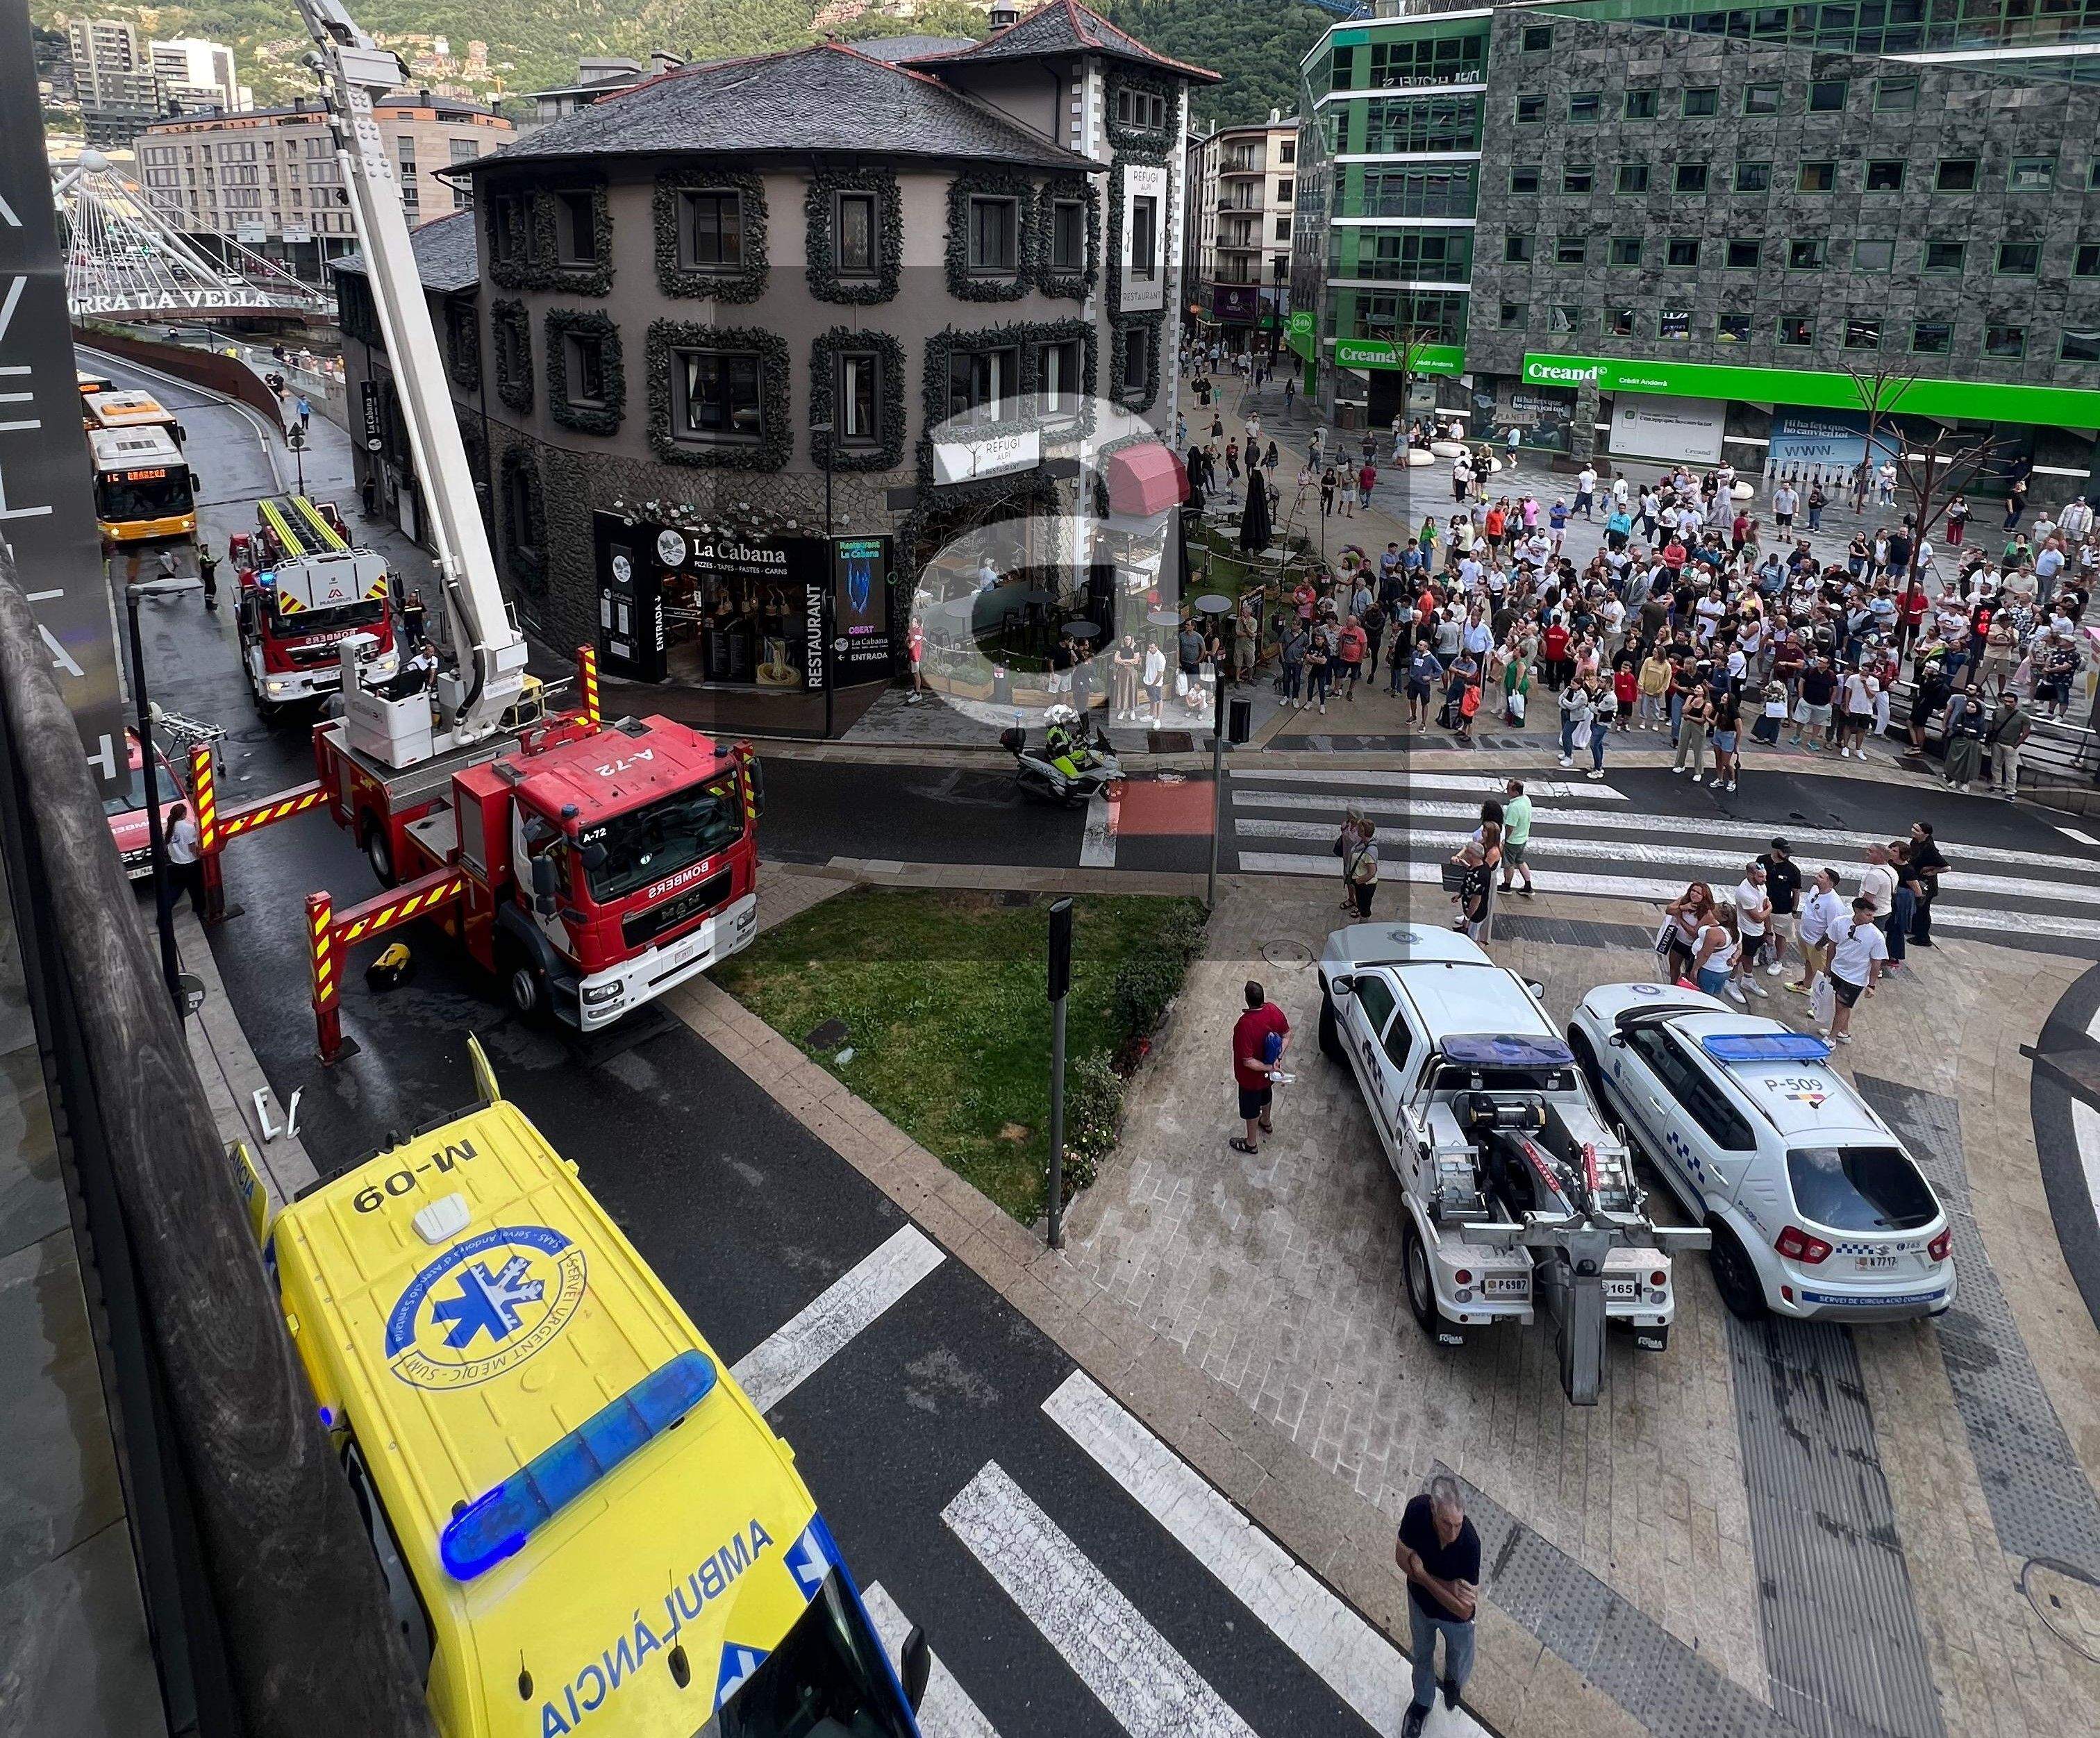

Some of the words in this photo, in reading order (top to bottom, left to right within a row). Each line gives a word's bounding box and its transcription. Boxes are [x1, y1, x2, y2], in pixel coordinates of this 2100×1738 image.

[1133, 170, 1158, 183] REFUGI
[139, 291, 178, 309] LA
[181, 290, 270, 308] VELLA
[1122, 290, 1162, 302] RESTAURANT
[1294, 318, 1310, 327] 24h
[1783, 424, 1796, 433] ho
[1797, 420, 1809, 428] ha
[1810, 421, 1826, 431] fets
[986, 437, 1021, 453] REFUGI
[985, 462, 1020, 476] RESTAURANT
[693, 538, 715, 558] La
[717, 542, 787, 563] Cabana
[840, 540, 881, 550] Restaurant
[840, 551, 850, 559] La
[850, 549, 879, 559] Cabana
[717, 563, 735, 571] TAPES
[739, 565, 760, 574] PASTES
[319, 596, 353, 605] MAGIRUS
[655, 603, 664, 651] ENTRADA
[849, 625, 874, 635] OBERT
[806, 583, 822, 687] RESTAURANT
[861, 637, 888, 646] Cabana
[851, 651, 888, 661] ENTRADA
[594, 748, 655, 777] A-72
[583, 828, 607, 843] A-72
[1764, 1078, 1824, 1092] P-509
[353, 1138, 478, 1214] M-09
[539, 1232, 562, 1249] SAAS
[1876, 1256, 1896, 1266] 7717
[563, 1257, 582, 1303] SERVEI
[1499, 1280, 1504, 1289] P
[1610, 1284, 1633, 1294] 165
[1819, 1296, 1847, 1305] SERVEI
[512, 1306, 569, 1362] URGENT
[405, 1358, 440, 1382] SUM
